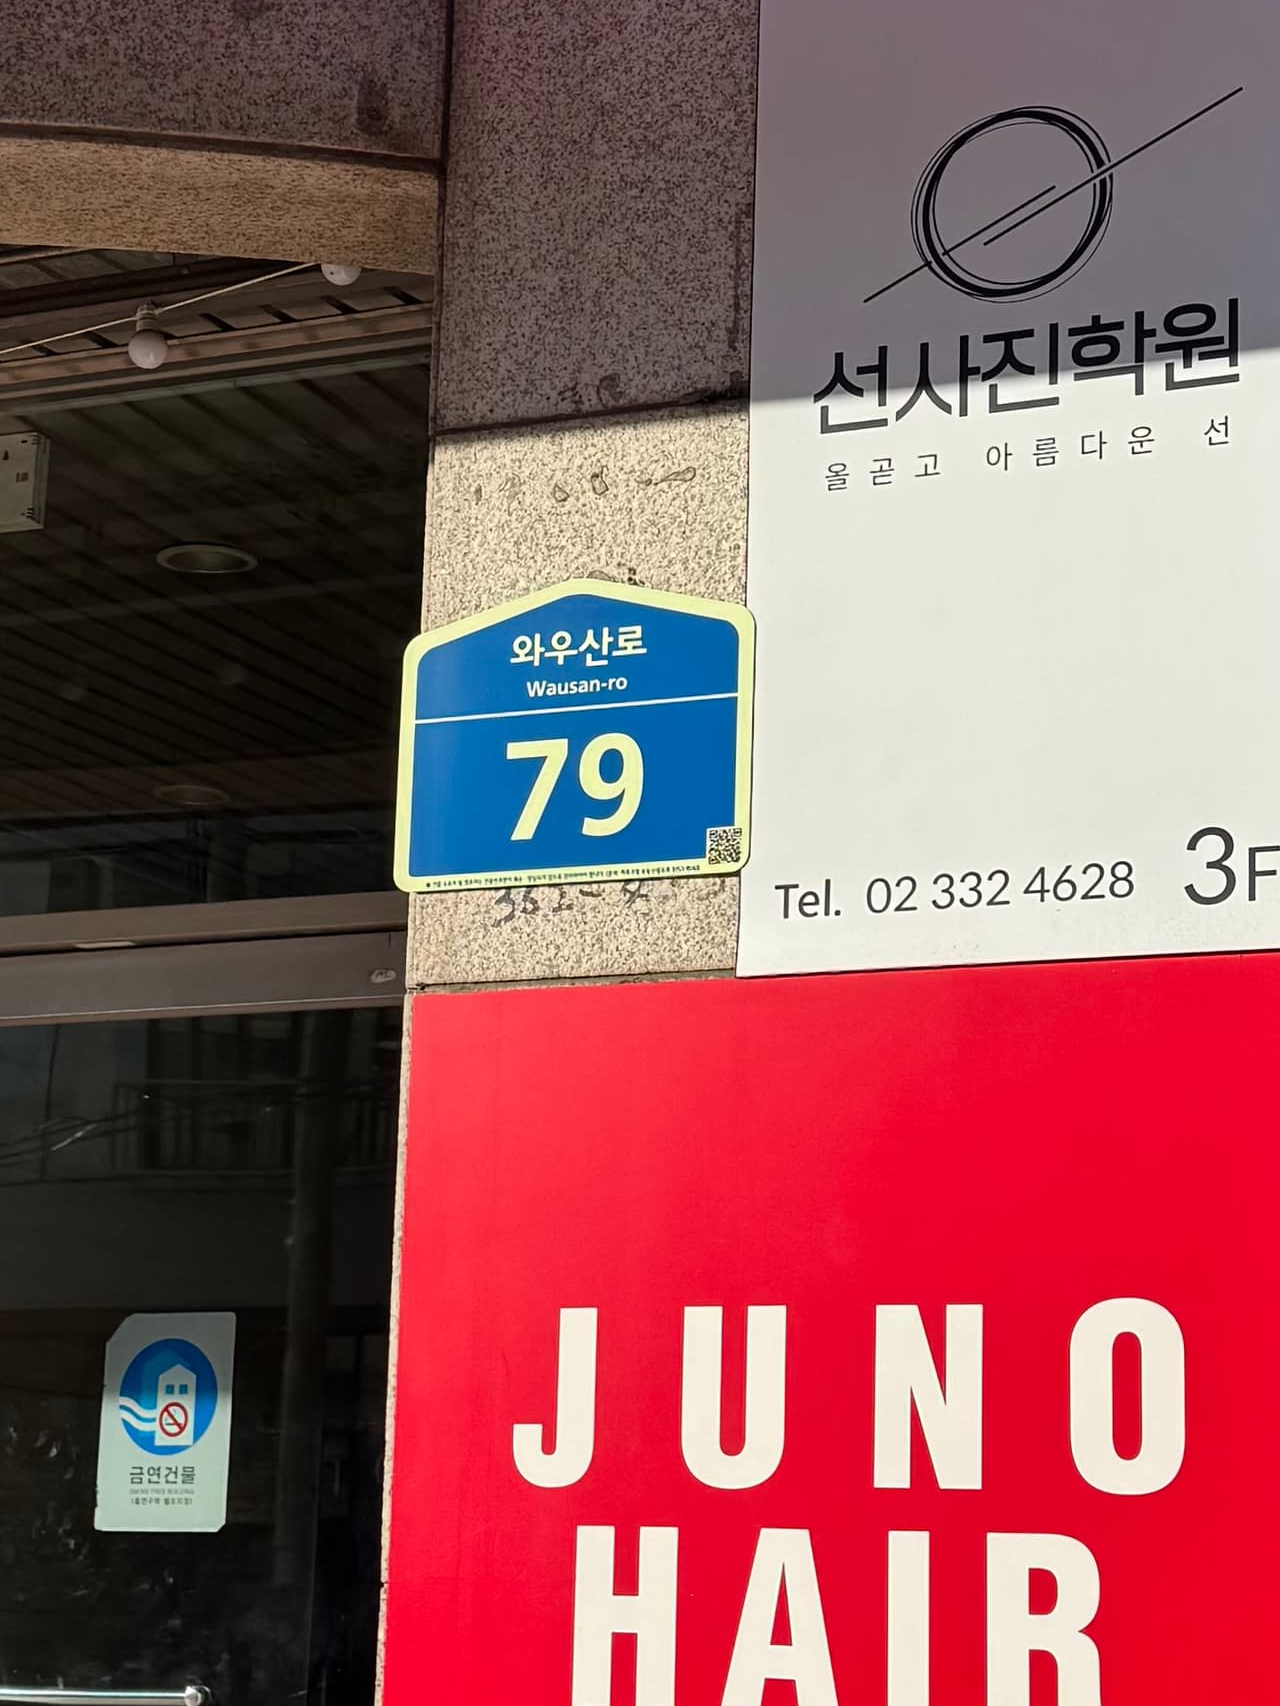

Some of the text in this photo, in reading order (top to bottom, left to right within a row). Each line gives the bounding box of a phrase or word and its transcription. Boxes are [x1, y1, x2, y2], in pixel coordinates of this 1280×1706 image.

[813, 298, 1240, 434] 선사진학원
[824, 415, 1231, 491] 올곧고 아름다운 선
[510, 624, 648, 668] 와우산로
[526, 673, 628, 698] Wausan-ro
[505, 732, 646, 841] 79
[774, 880, 843, 920] Tel.
[865, 877, 919, 916] 02
[930, 870, 1012, 909] 332
[1022, 860, 1135, 904] 4628
[511, 1296, 1187, 1496] JUNO
[129, 1466, 196, 1484] 금연건물
